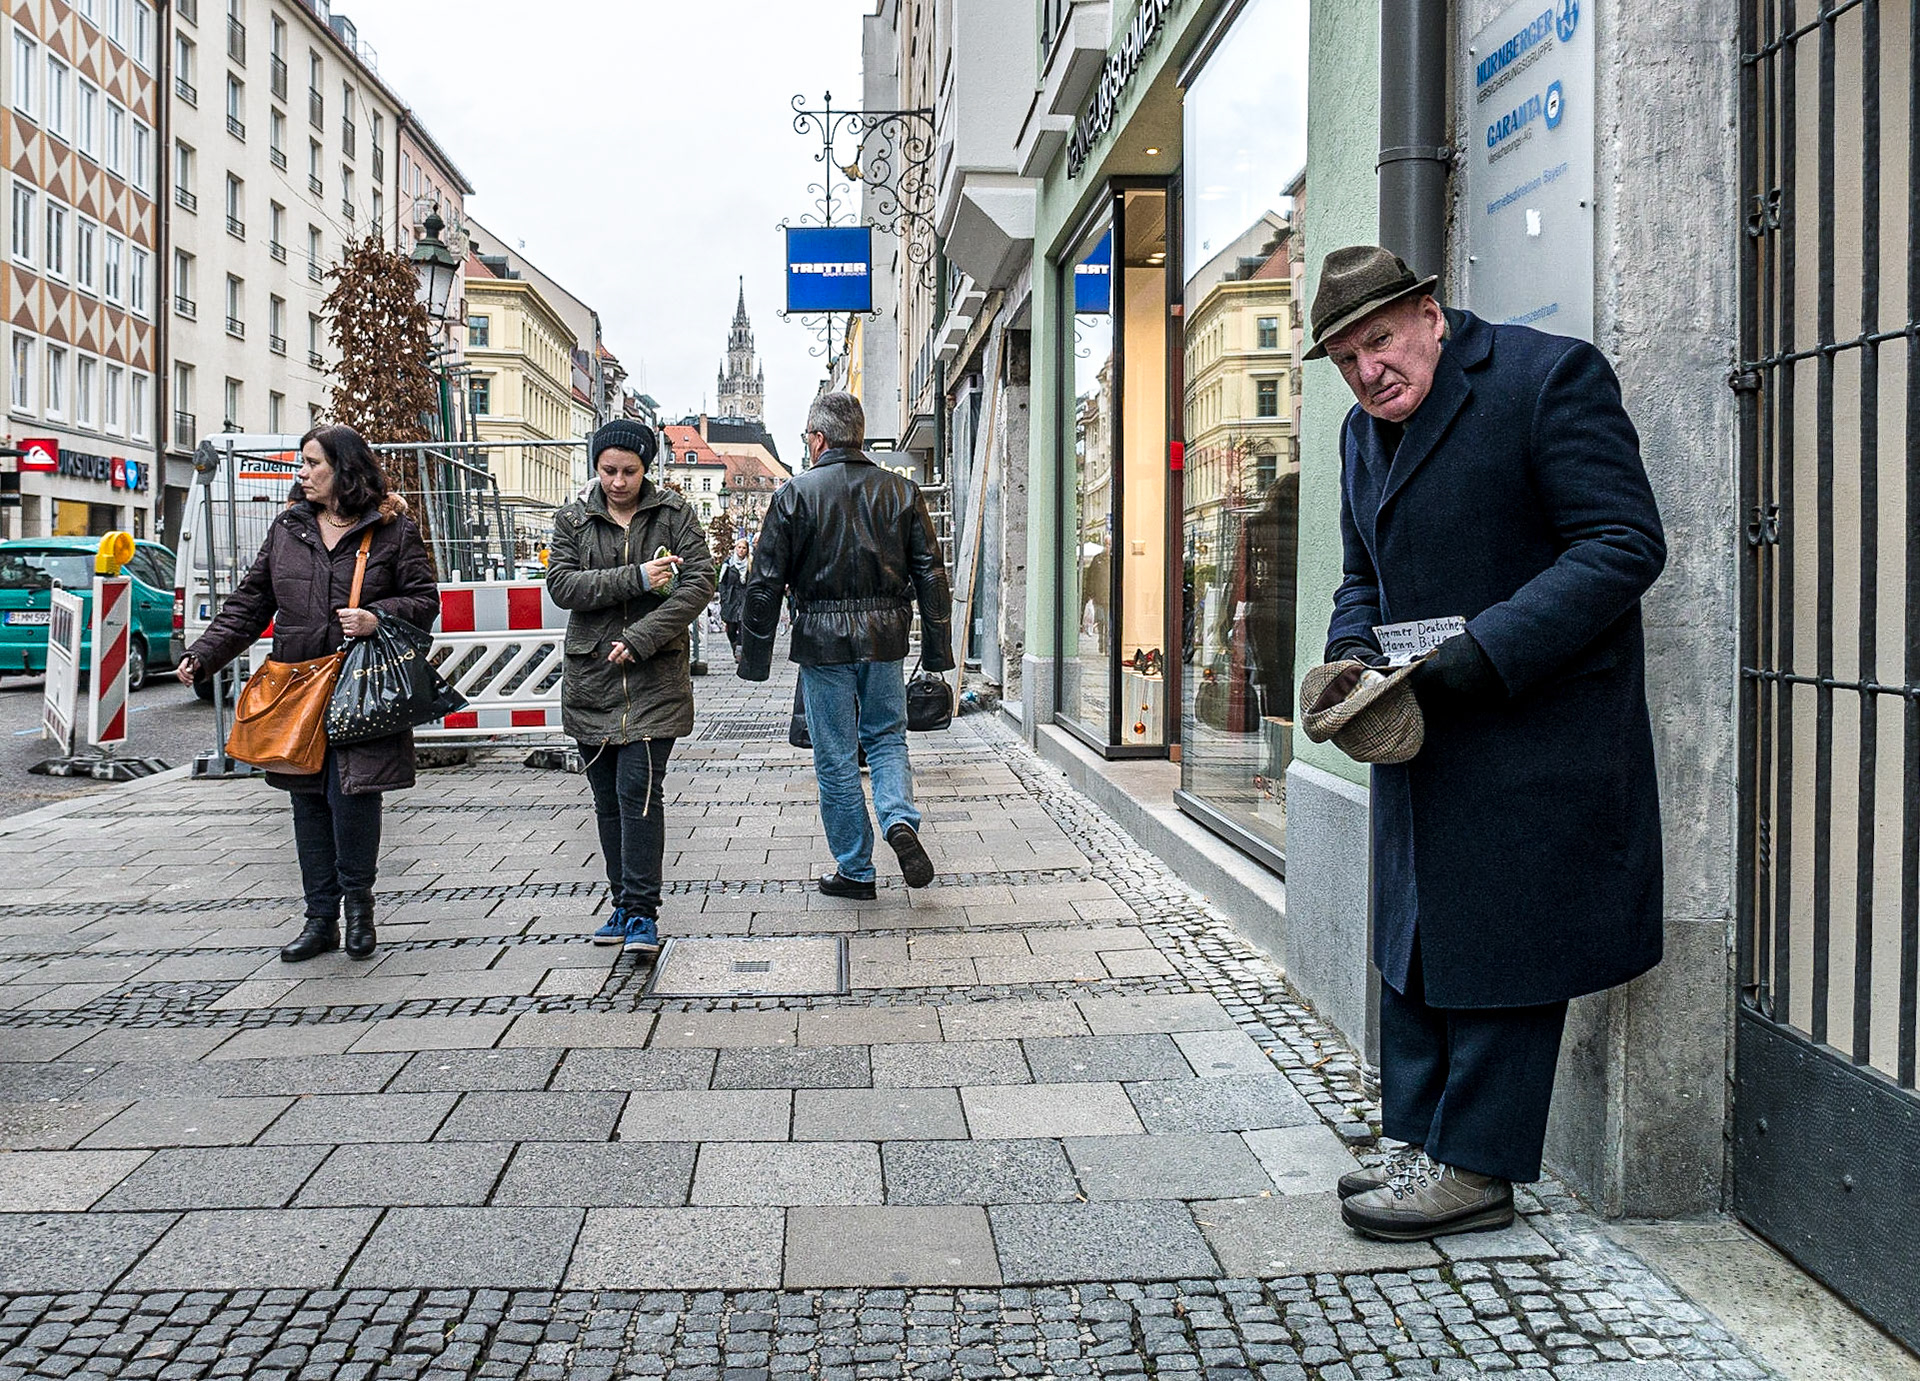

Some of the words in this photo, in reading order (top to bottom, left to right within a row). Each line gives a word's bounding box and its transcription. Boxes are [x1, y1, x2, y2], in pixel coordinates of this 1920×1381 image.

[1487, 93, 1541, 148] GARANTA
[790, 263, 867, 273] TRETTER
[1382, 640, 1415, 652] Mann
